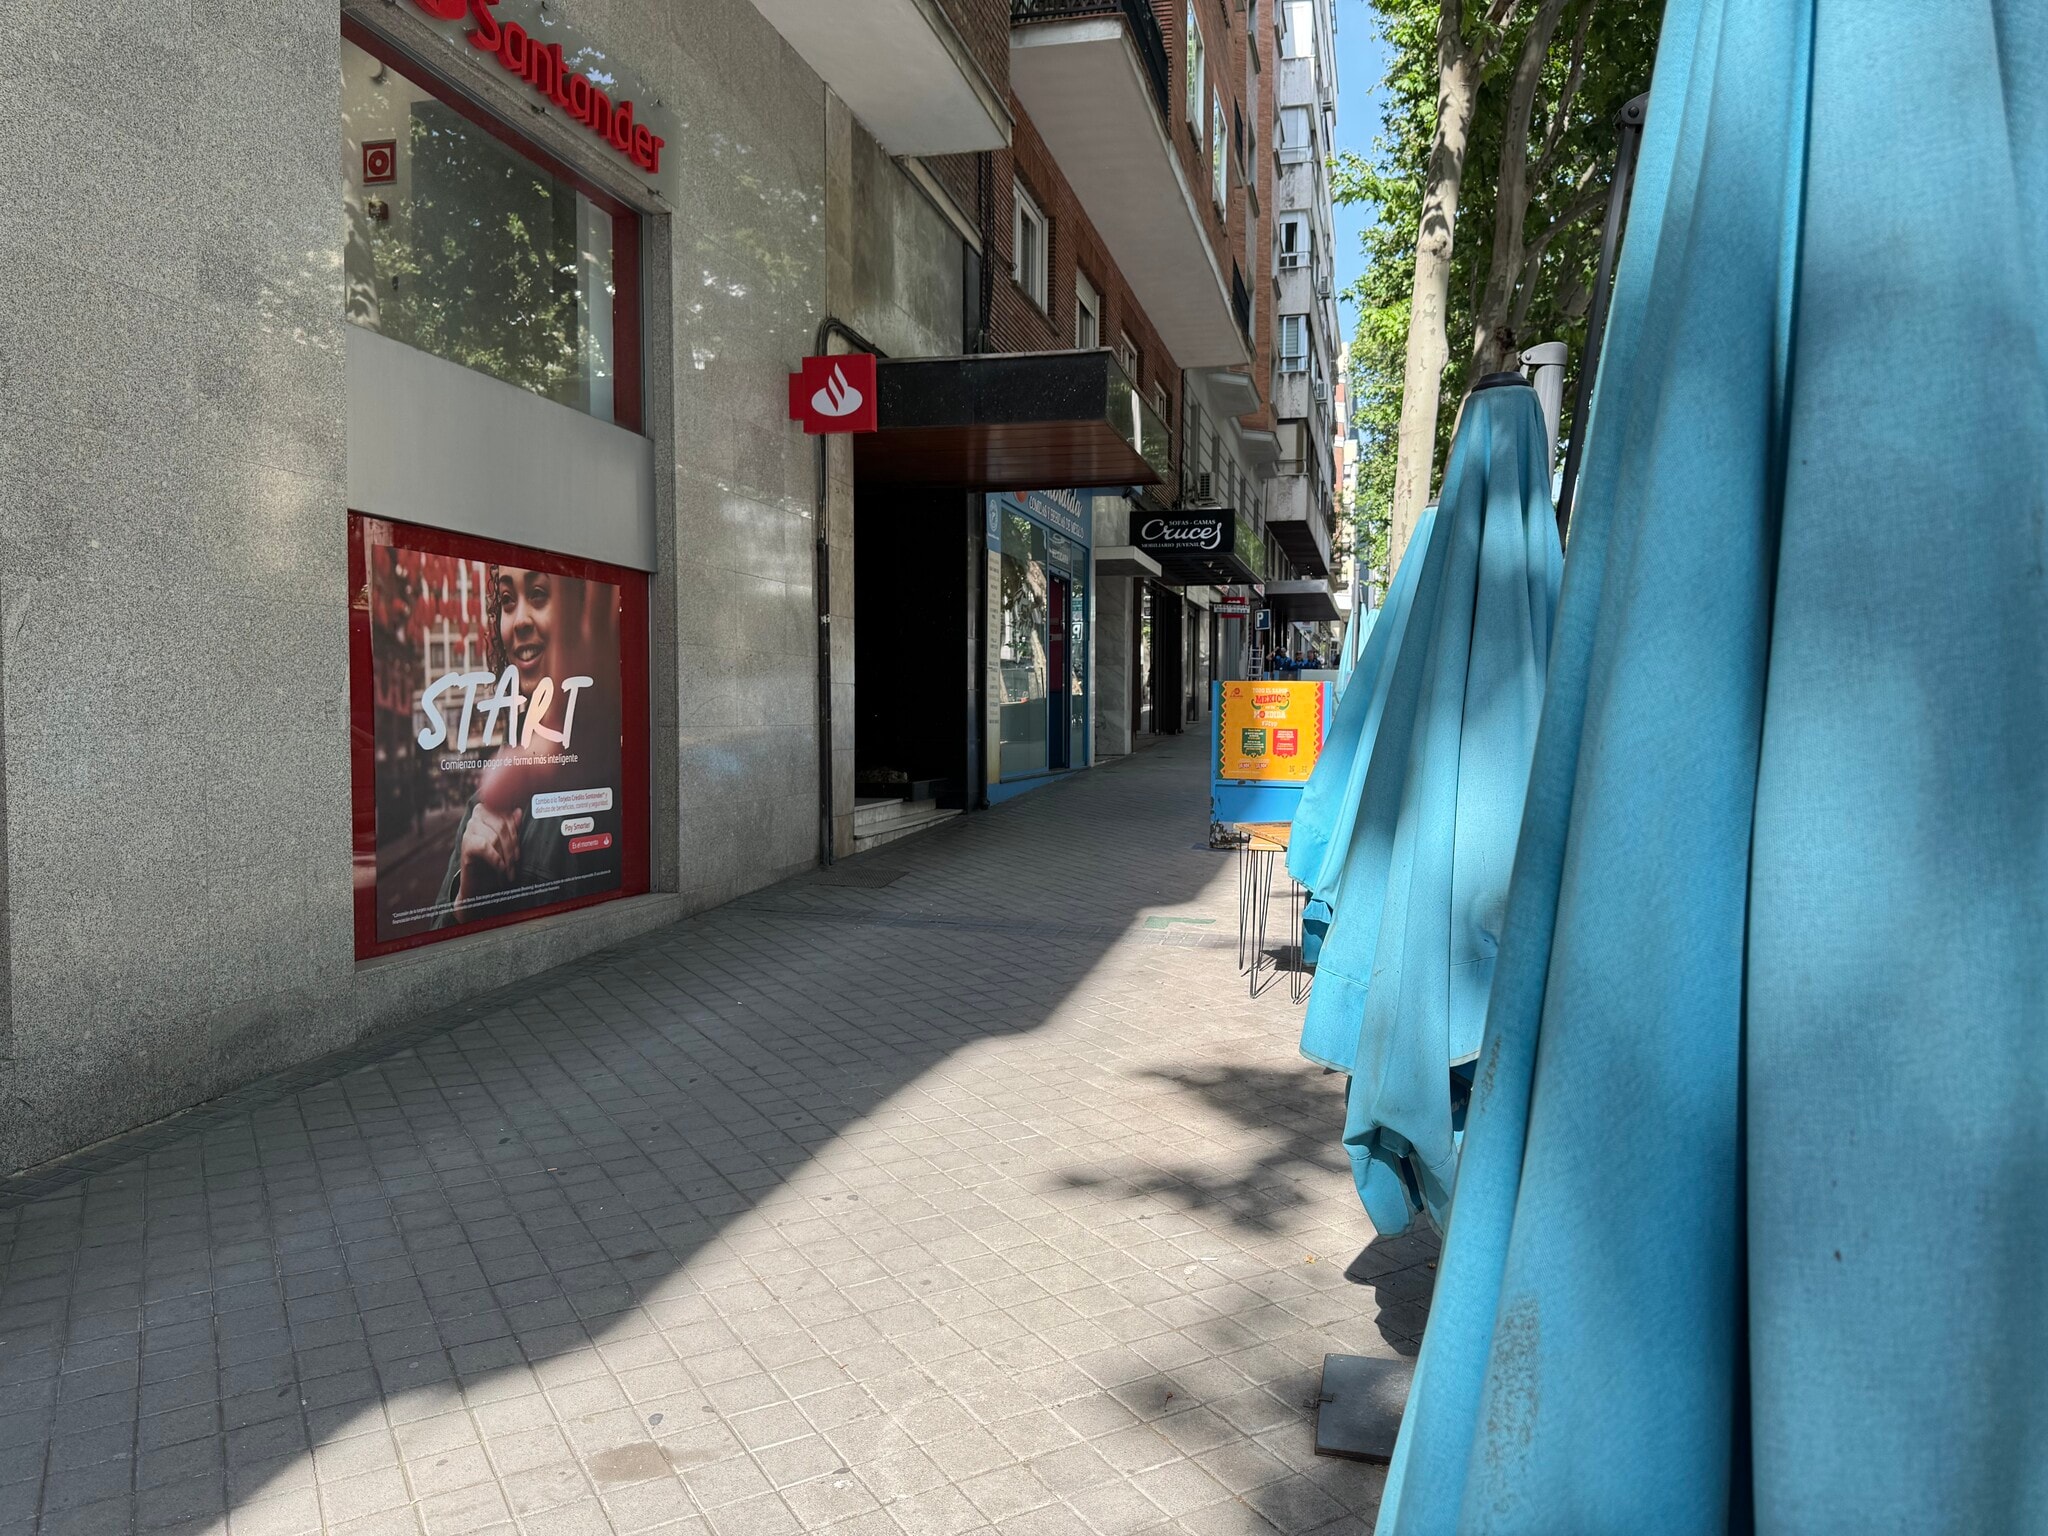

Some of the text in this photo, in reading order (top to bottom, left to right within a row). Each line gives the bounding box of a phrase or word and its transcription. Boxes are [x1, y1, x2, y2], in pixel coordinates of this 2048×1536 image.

[466, 0, 665, 174] Santander
[1141, 519, 1222, 550] Cruces
[1256, 612, 1264, 628] P
[417, 664, 594, 754] START
[440, 753, 579, 771] Comienza a pagar de forma más inteligente
[565, 822, 591, 833] Pay Smarter
[576, 841, 580, 849] el
[580, 839, 599, 848] momento
